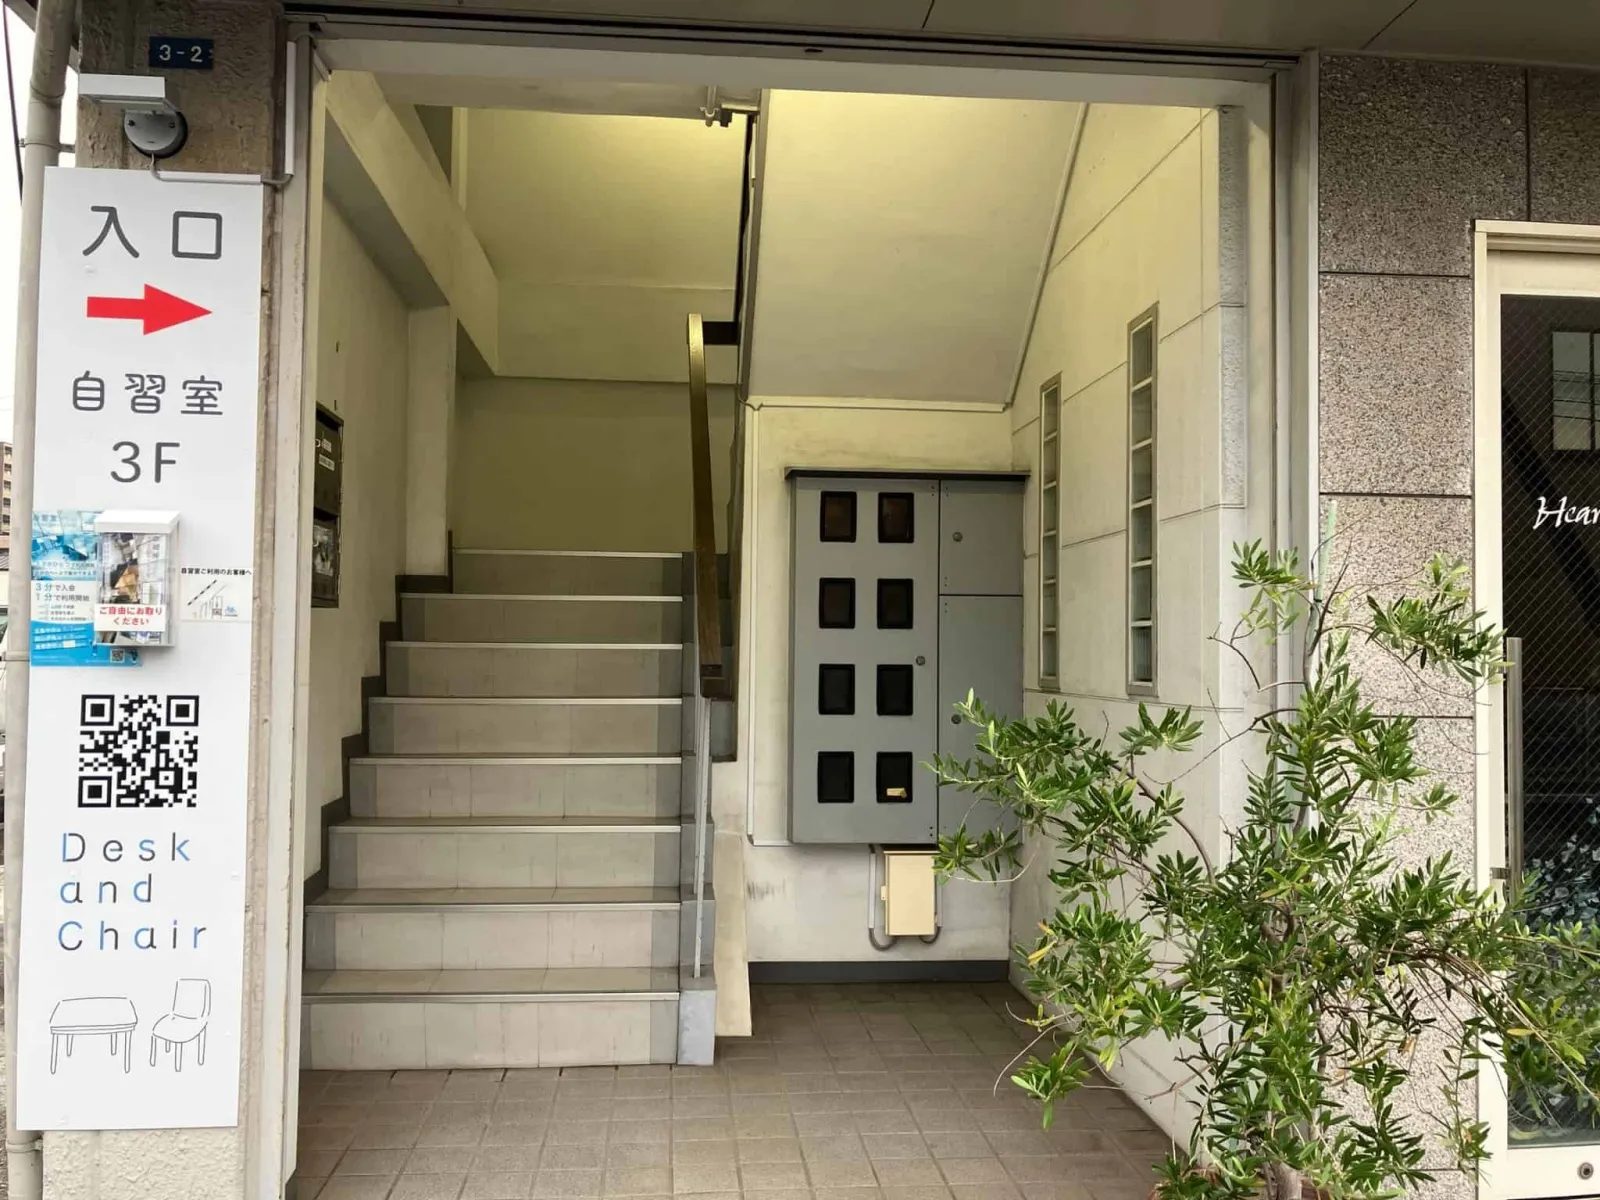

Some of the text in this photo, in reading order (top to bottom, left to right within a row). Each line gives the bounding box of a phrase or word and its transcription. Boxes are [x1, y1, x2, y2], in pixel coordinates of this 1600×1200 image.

[159, 44, 213, 63] 3-2
[83, 205, 223, 259] 入口
[72, 370, 223, 416] 自習室
[110, 440, 181, 484] 3F
[99, 606, 163, 616] ご自由にお取り
[113, 617, 150, 626] ください
[61, 832, 191, 863] Desk
[59, 874, 153, 905] and
[57, 920, 206, 951] Chair
